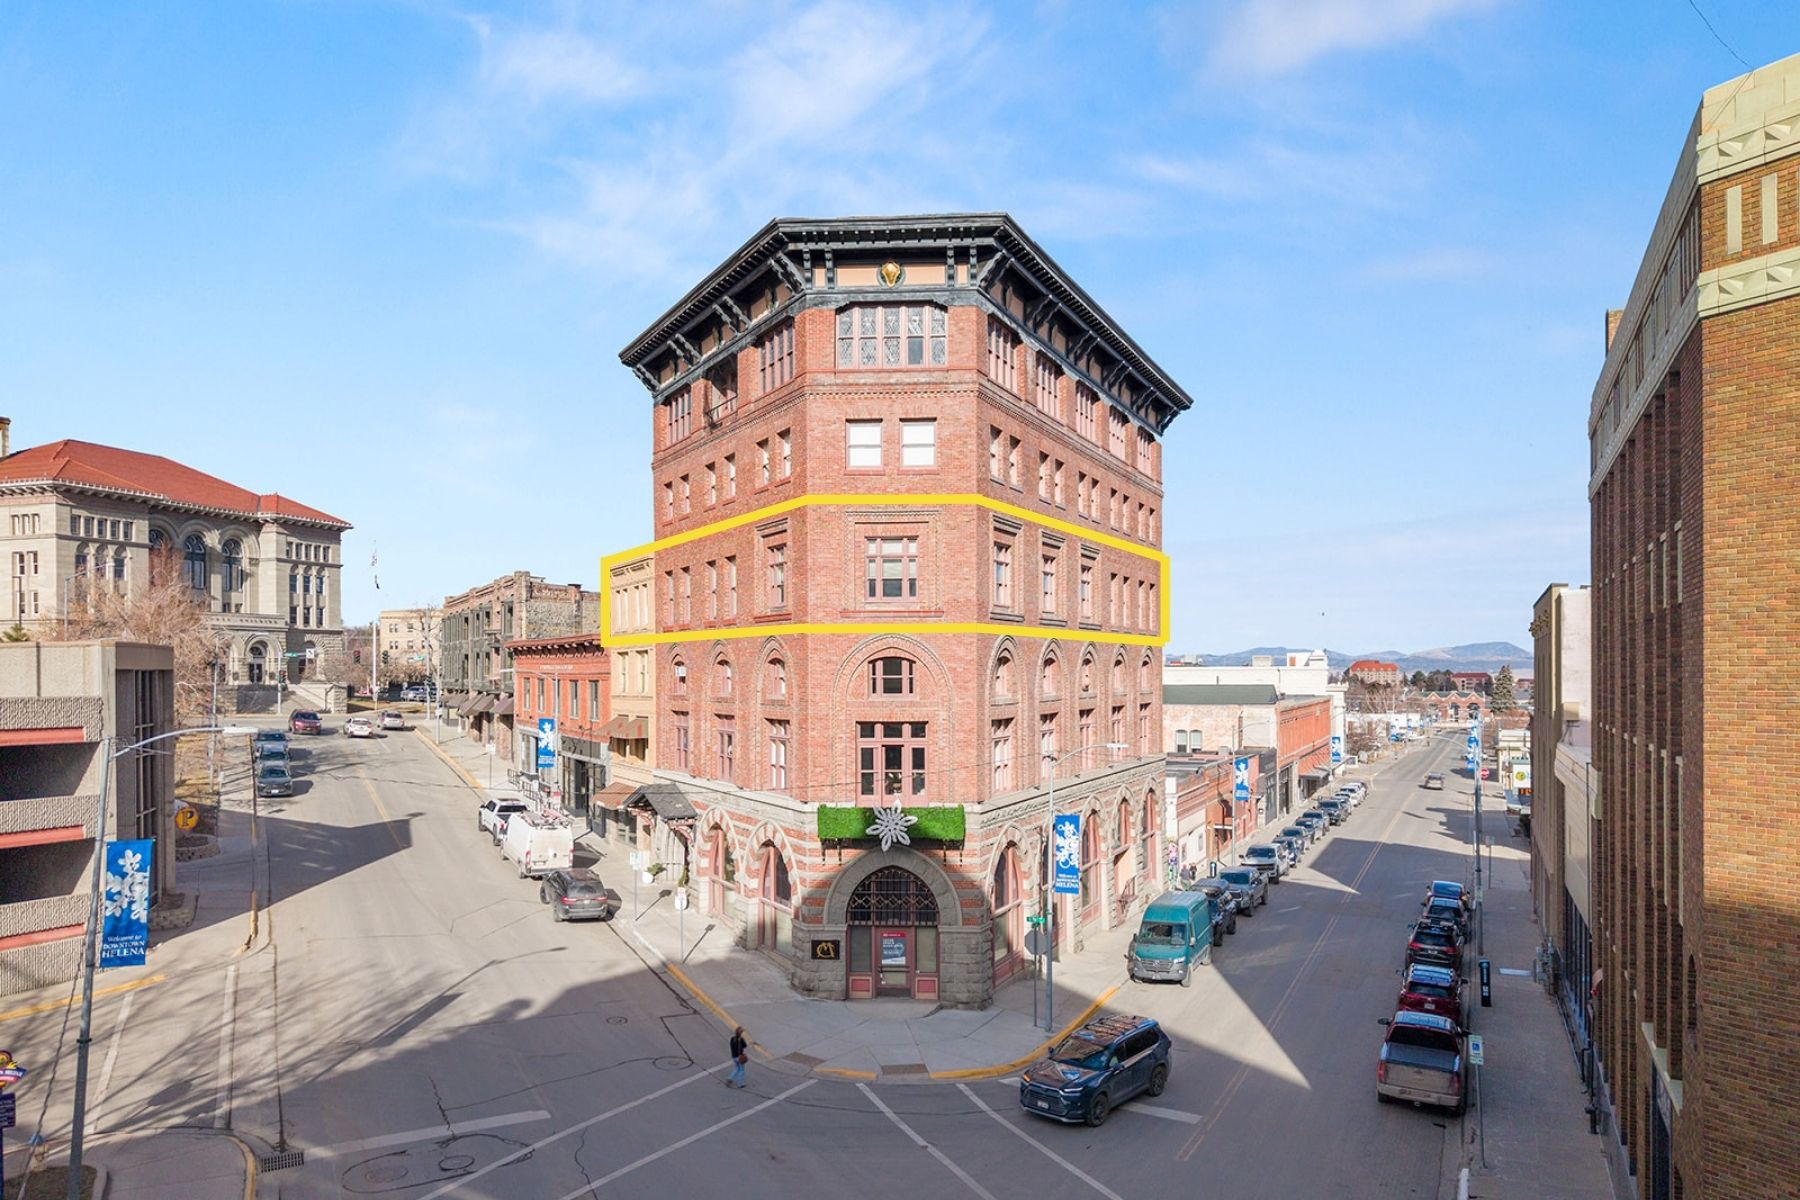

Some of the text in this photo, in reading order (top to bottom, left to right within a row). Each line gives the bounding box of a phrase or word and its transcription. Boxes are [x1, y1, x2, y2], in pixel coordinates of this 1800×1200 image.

[181, 809, 195, 827] P
[103, 941, 145, 949] DOWNTOWN
[102, 947, 145, 958] HELENA
